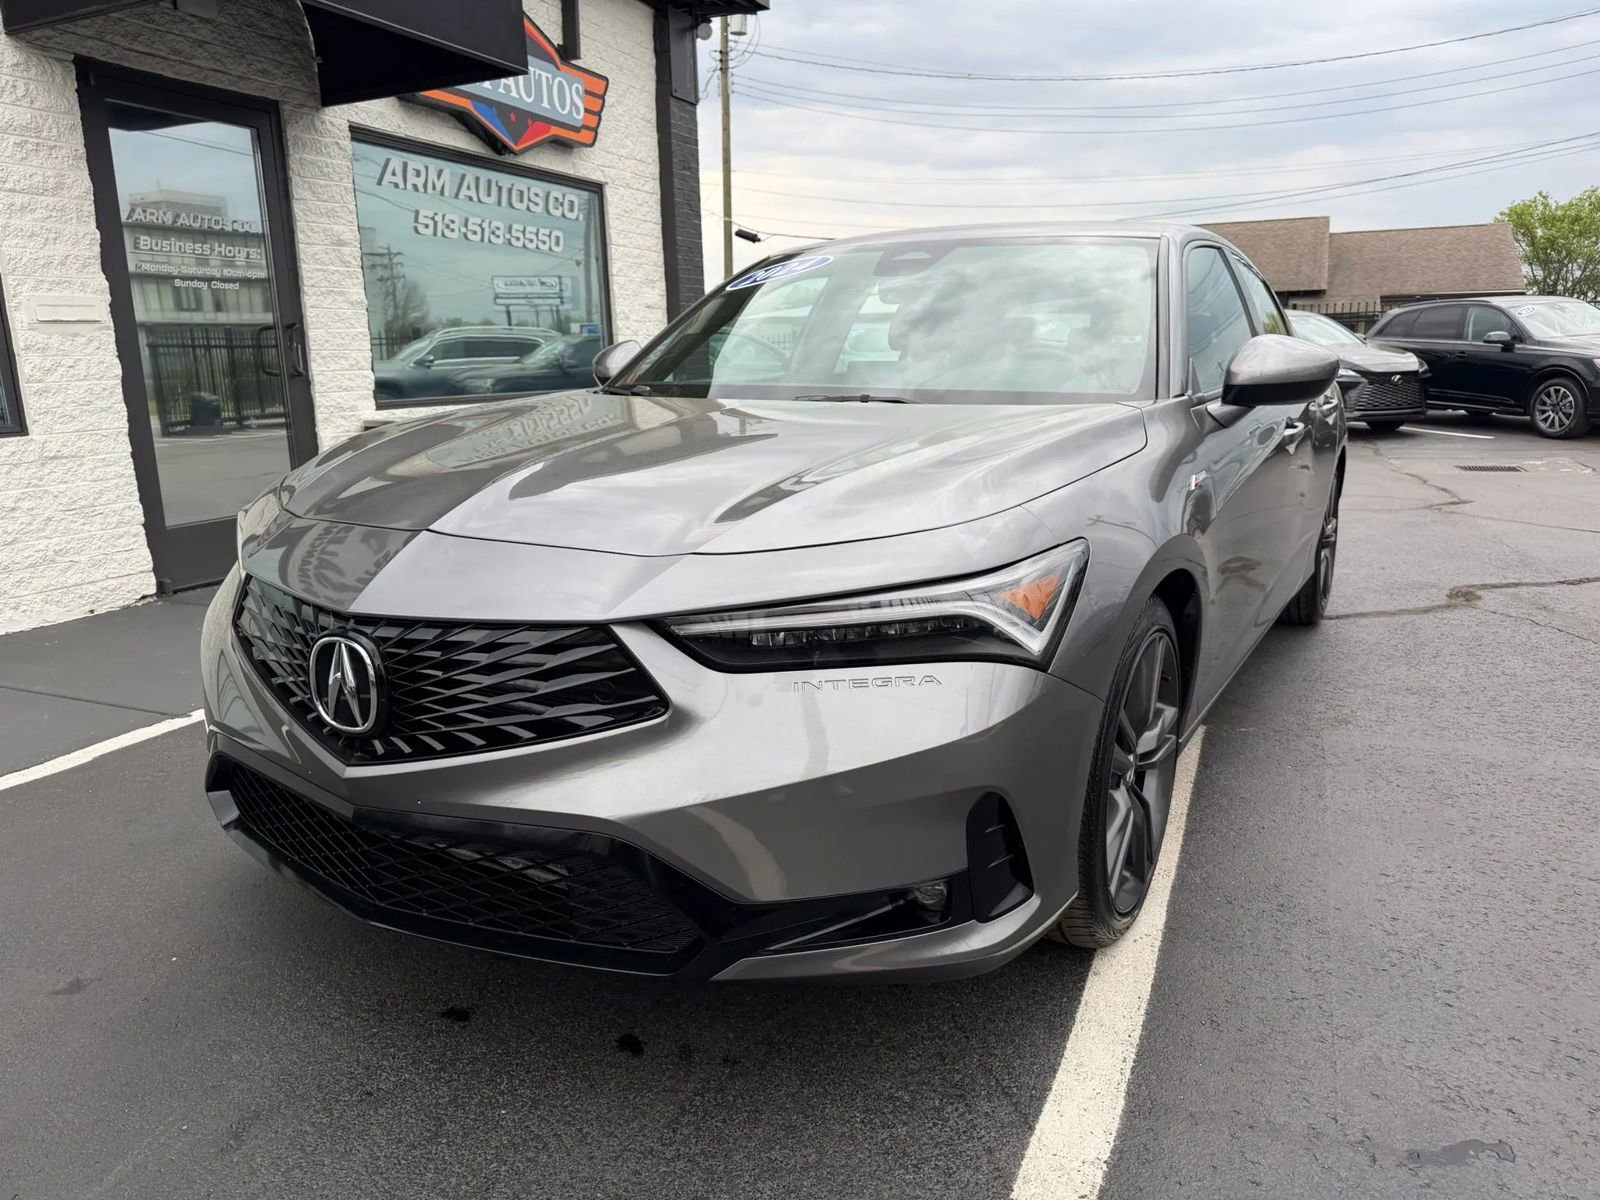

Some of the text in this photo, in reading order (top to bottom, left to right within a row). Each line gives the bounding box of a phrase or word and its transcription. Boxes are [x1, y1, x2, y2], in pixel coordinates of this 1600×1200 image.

[378, 157, 585, 222] ARM AUTOS CO.
[130, 206, 173, 225] ARM
[415, 208, 565, 253] 513-513-5550
[137, 235, 262, 259] Business Hours:
[141, 263, 221, 278] Monday-Saturday
[174, 278, 240, 290] Sunday Closed
[793, 674, 943, 693] INTEGRA
